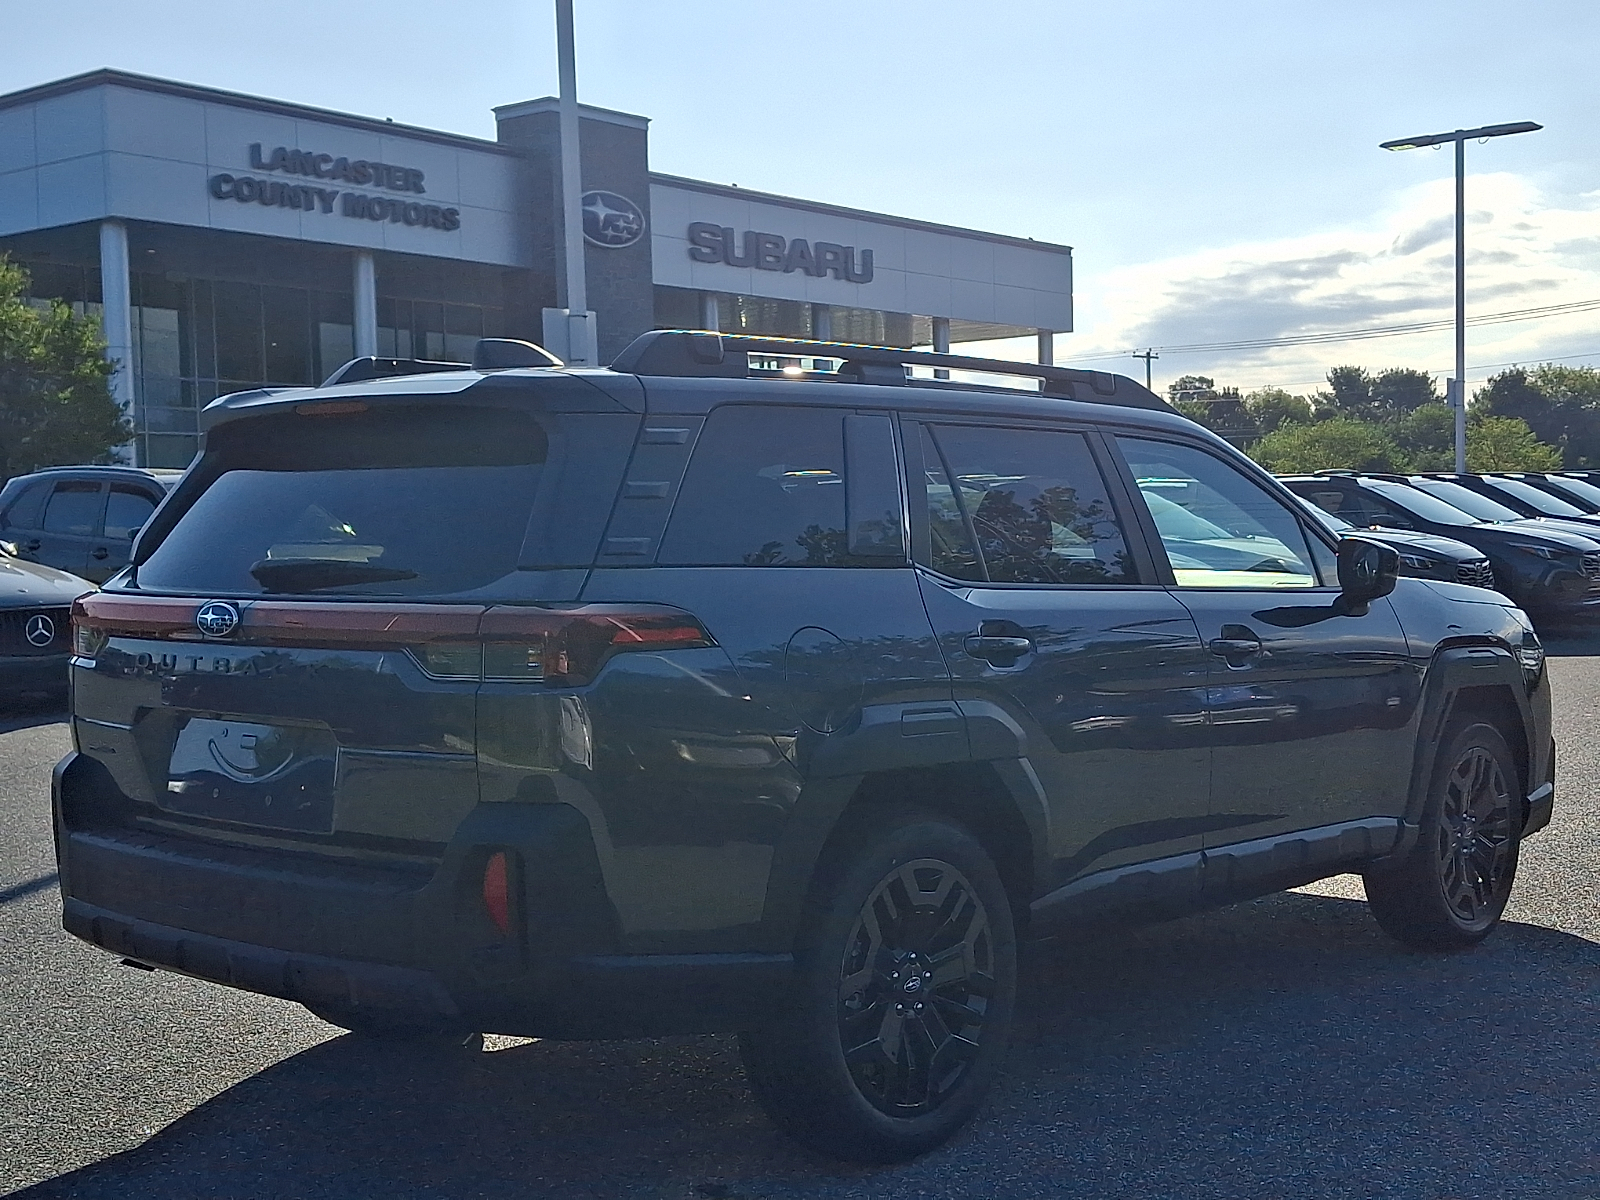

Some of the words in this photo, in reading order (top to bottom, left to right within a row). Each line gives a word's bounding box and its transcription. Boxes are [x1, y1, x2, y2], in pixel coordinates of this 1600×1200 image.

[249, 142, 426, 194] LANCASTER
[208, 173, 340, 214] COUNTY
[341, 192, 461, 231] MOTORS
[687, 221, 874, 285] SUBARU
